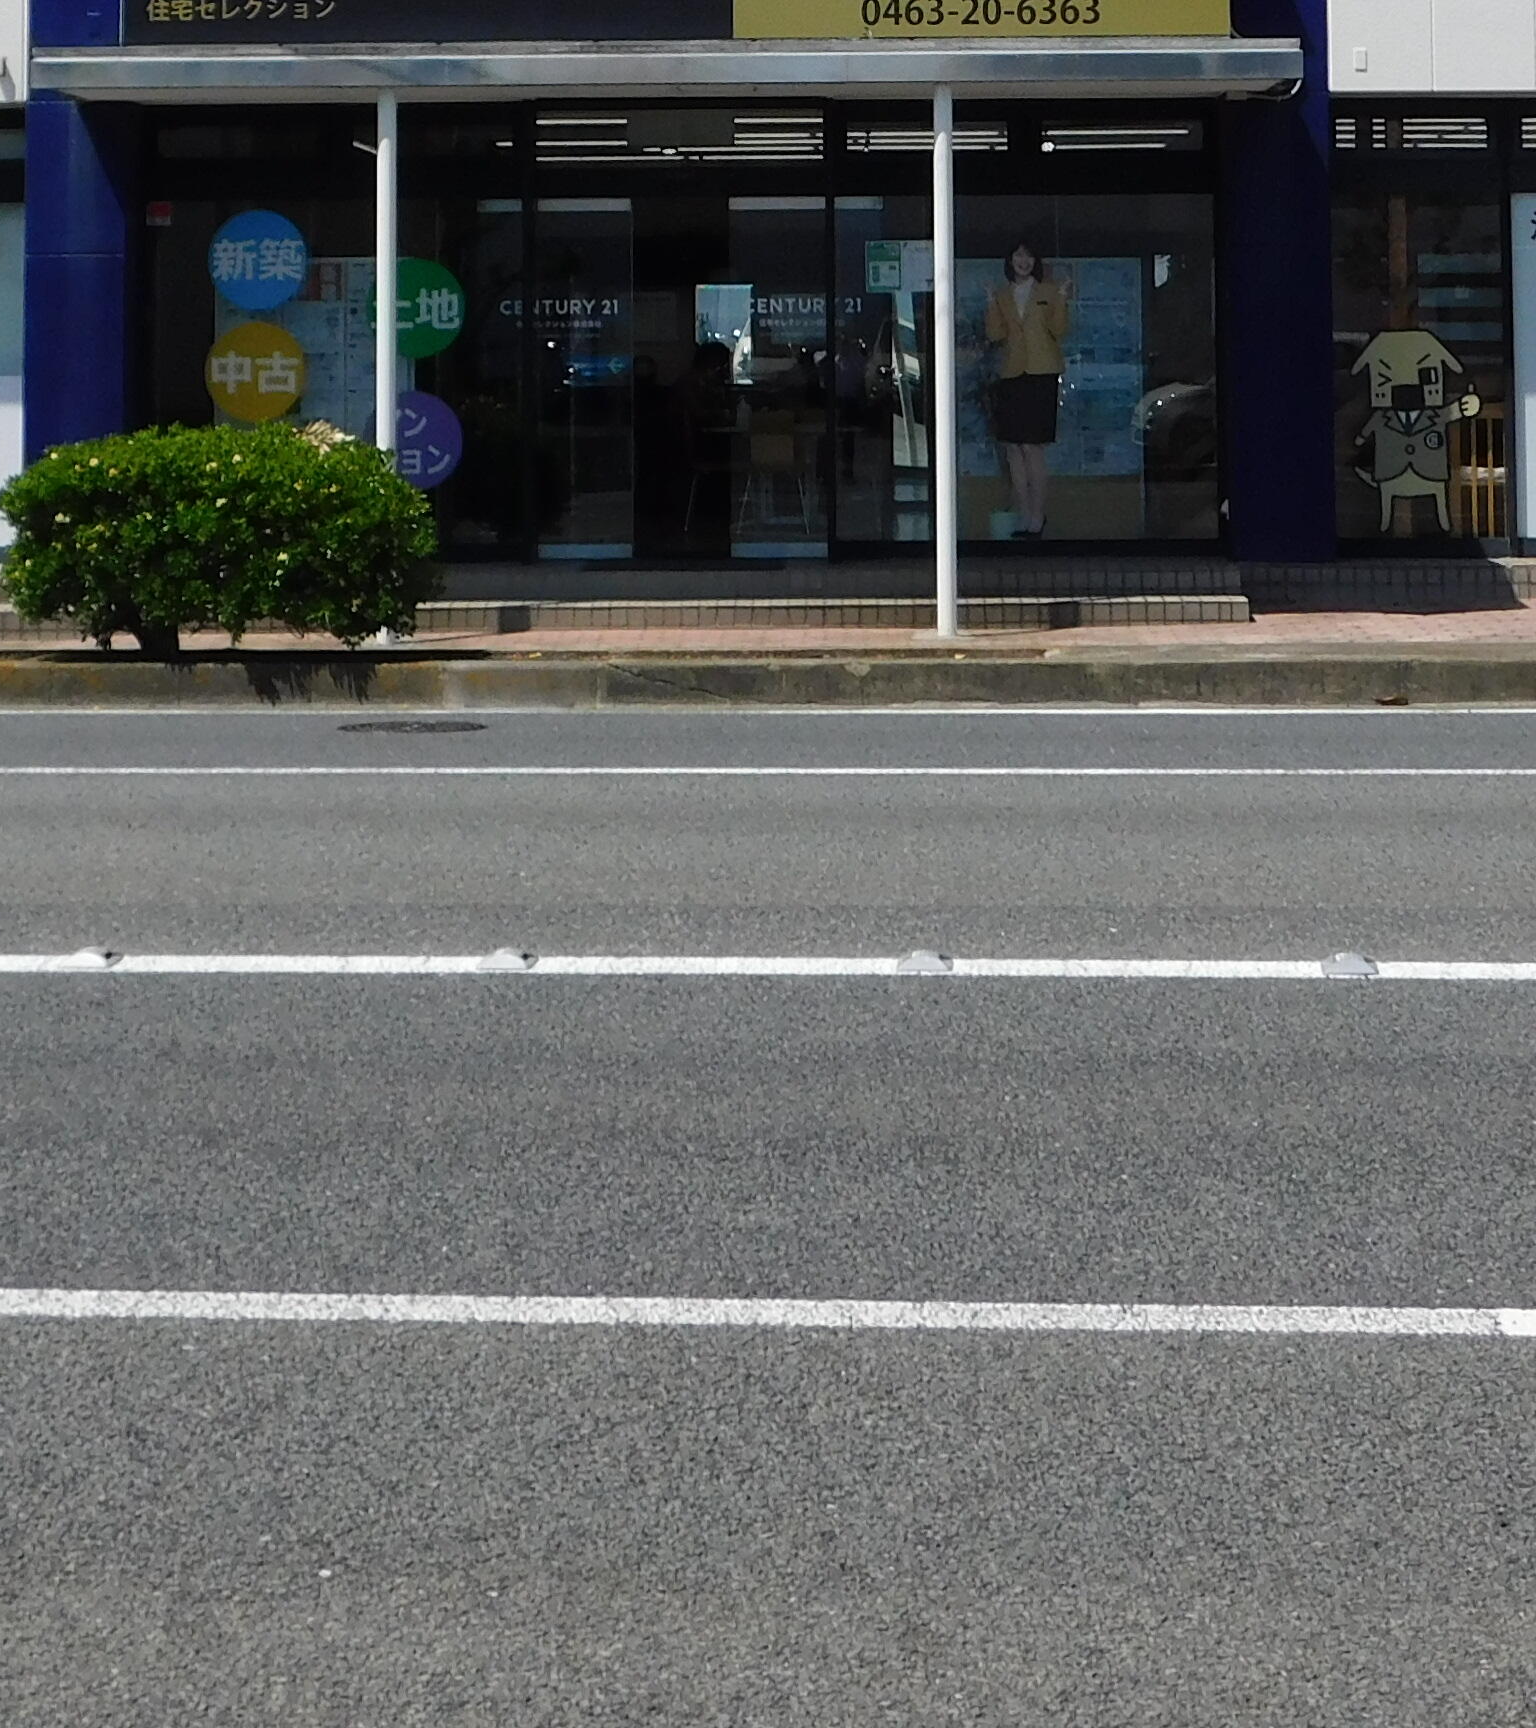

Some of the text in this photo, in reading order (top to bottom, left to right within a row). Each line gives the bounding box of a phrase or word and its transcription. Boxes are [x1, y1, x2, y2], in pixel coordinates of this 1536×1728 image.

[211, 237, 306, 282] 新築
[600, 298, 619, 316] 21
[750, 297, 863, 315] ENTUR 21
[209, 350, 299, 395] 中古
